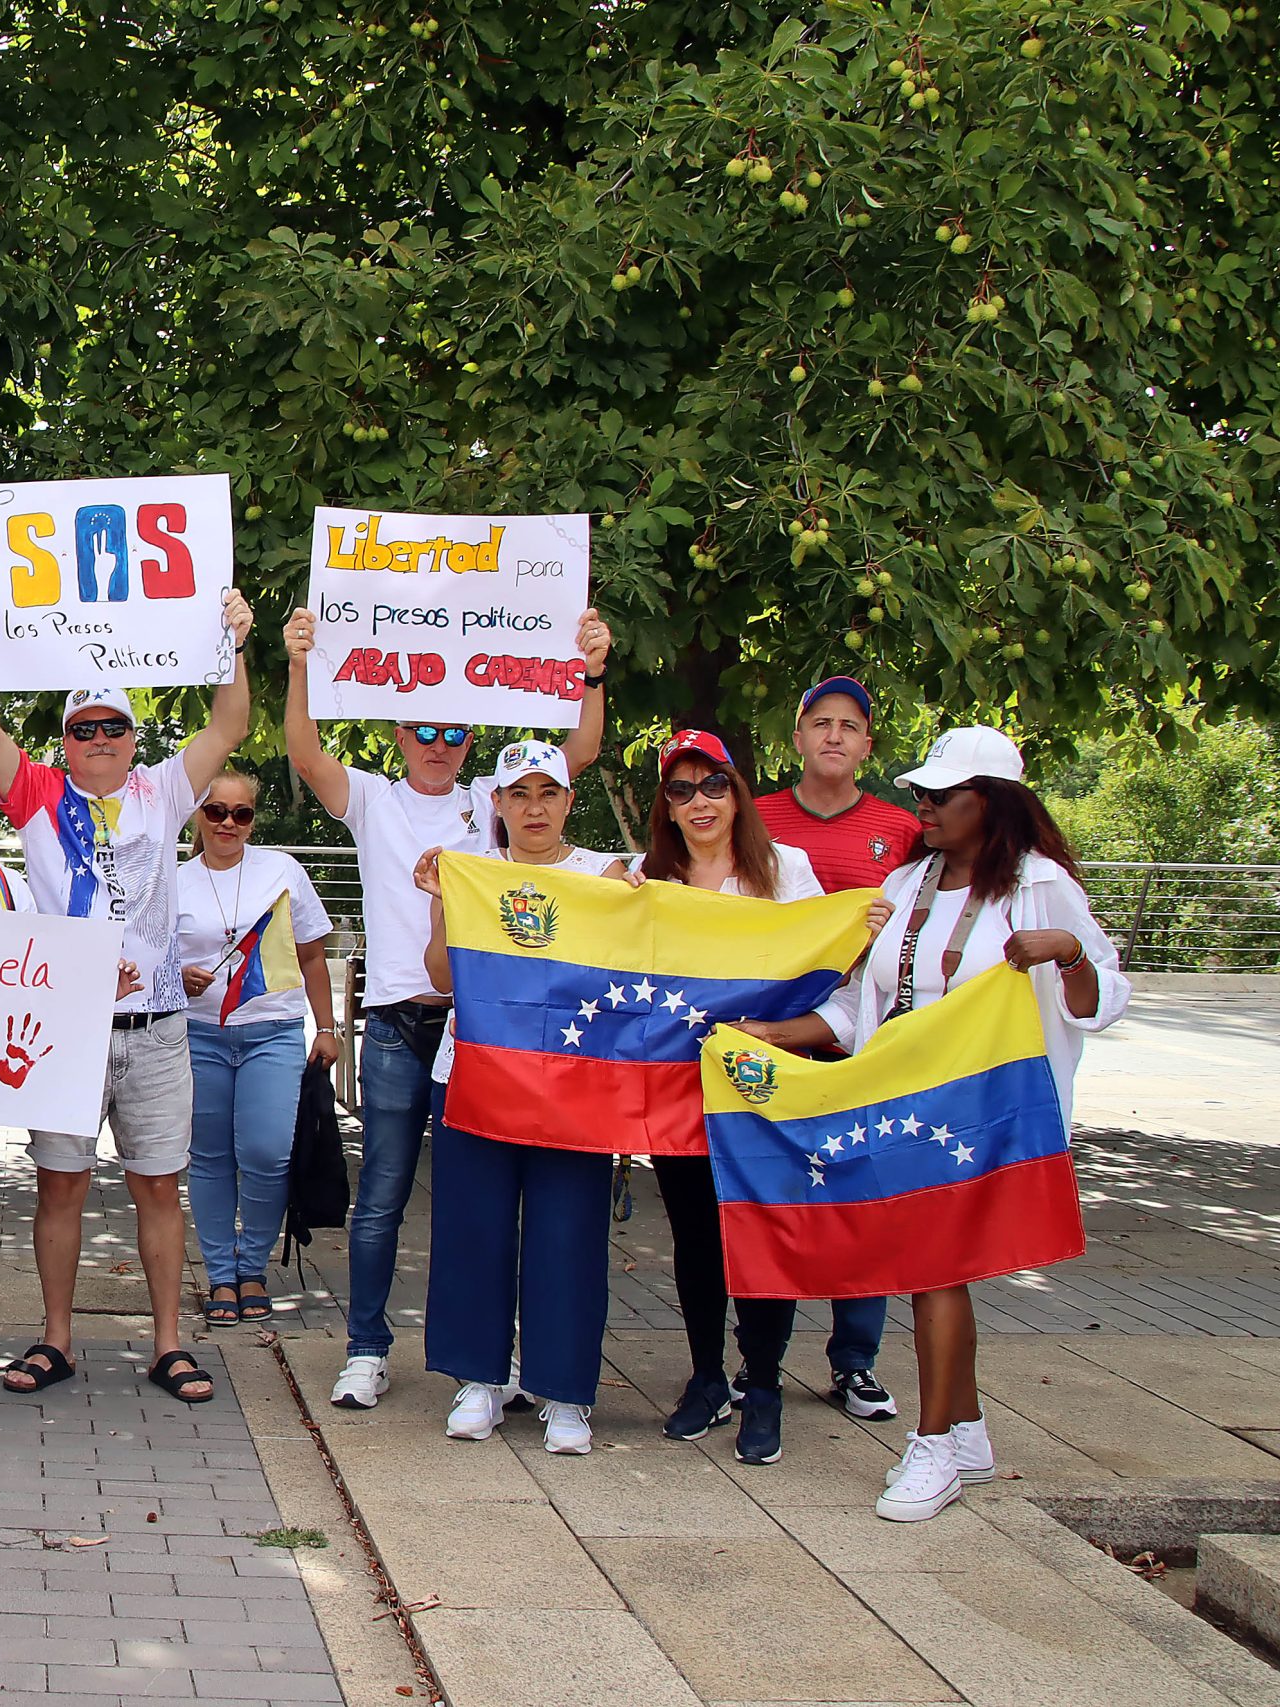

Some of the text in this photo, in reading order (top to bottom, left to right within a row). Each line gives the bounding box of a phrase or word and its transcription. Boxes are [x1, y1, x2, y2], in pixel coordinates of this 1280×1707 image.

[325, 514, 564, 587] Libertad para
[5, 609, 39, 640] los
[41, 611, 113, 636] Presos
[319, 592, 359, 623] los
[373, 604, 450, 636] presos
[332, 647, 587, 701] ABAJO CADENAS
